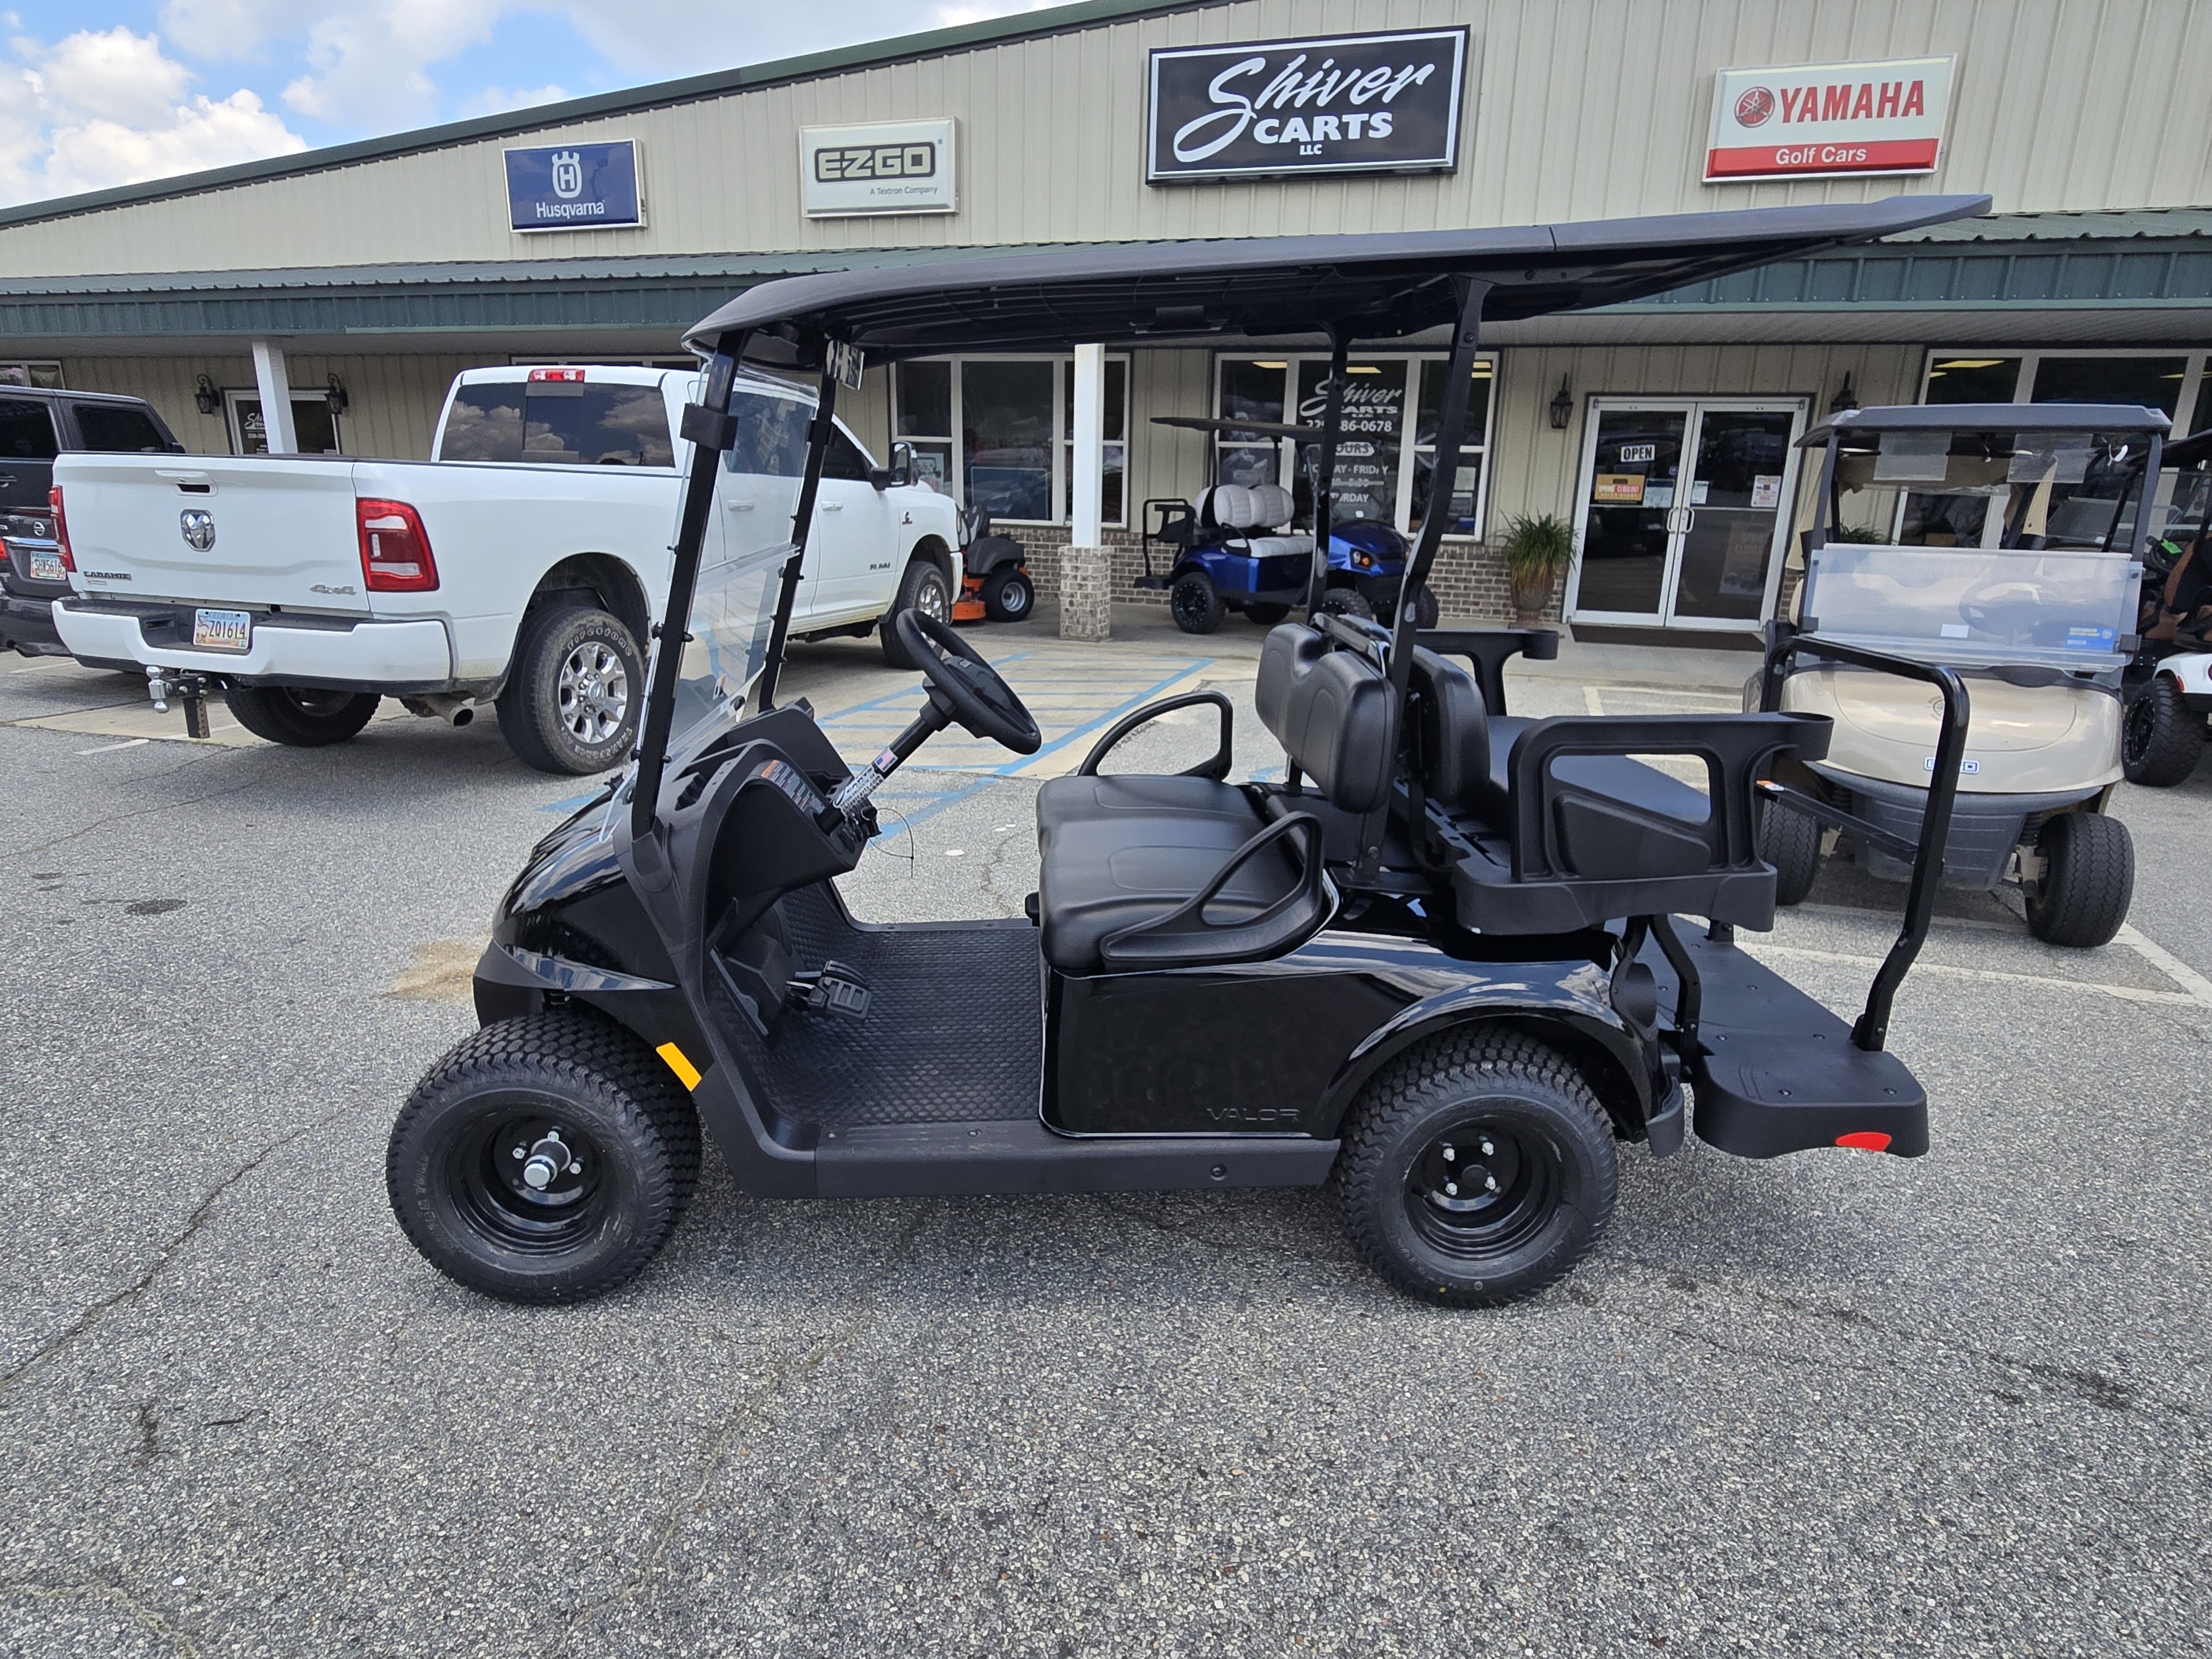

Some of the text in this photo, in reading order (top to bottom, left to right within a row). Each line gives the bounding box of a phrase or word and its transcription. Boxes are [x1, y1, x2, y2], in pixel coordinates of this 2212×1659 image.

[1173, 54, 1436, 163] Shiver
[1780, 80, 1924, 124] YAMAHA
[1253, 112, 1393, 144] CARTS
[1300, 144, 1322, 155] LLC
[1775, 146, 1867, 165] Golf Cars
[818, 145, 931, 180] EZGO
[877, 187, 903, 195] Textron
[904, 186, 938, 195] Company
[536, 202, 604, 220] Husqvarna
[1340, 405, 1399, 414] ARTS
[1623, 447, 1652, 461] OPEN
[82, 571, 132, 581] LARAMIE
[1206, 1108, 1300, 1123] VALOR
